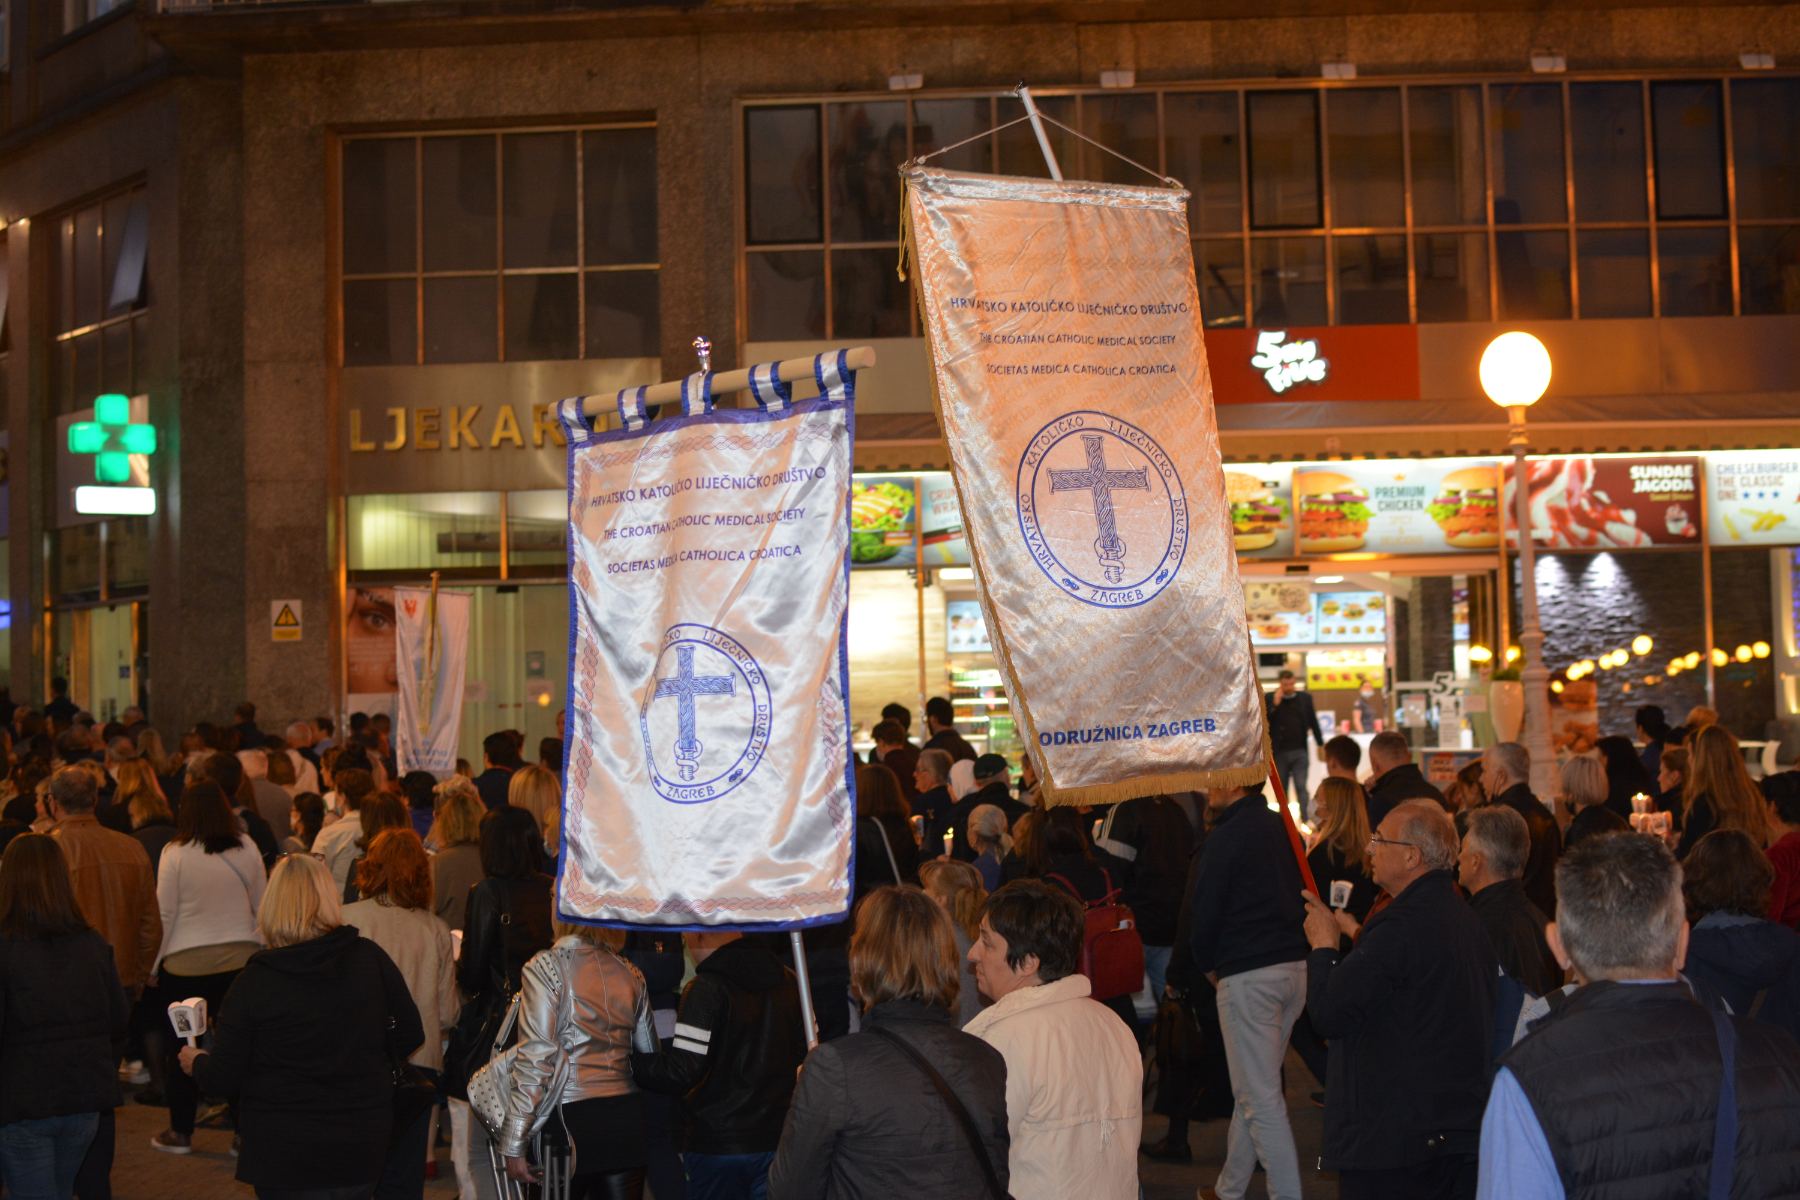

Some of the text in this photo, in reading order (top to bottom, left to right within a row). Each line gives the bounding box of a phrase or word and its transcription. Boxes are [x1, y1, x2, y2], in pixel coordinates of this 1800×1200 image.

[950, 297, 1188, 316] HRVATSKO KATOLIČKO LIJEČNIČKO DRUŠTVO
[993, 334, 1045, 345] CROATIAN
[1047, 333, 1095, 345] CATHOLIC
[1096, 336, 1138, 346] MEDICAL
[1139, 335, 1176, 345] SOCIETY
[986, 363, 1177, 376] SOCIETAS MEDICA CATHOLICA CROATICA
[1025, 416, 1084, 469] KATOLIČKO
[1629, 464, 1694, 479] SUNDAE
[591, 489, 636, 507] HRVATSKO
[695, 475, 771, 490] LIJEČNIČKO
[772, 466, 826, 485] DRUŠTVO
[1632, 479, 1695, 493] JAGODA
[1740, 475, 1784, 487] CLASSIC
[1374, 486, 1425, 499] PREMIUM
[1377, 499, 1424, 512] CHICKEN
[604, 528, 618, 540] THE
[620, 521, 671, 538] CROATIAN
[714, 514, 765, 526] MEDICAL
[766, 508, 806, 524] SOCIETY
[1021, 494, 1055, 571] HRVATSKO
[607, 559, 655, 574] SOCIETAS
[679, 550, 746, 561] CATHOLICA
[1090, 589, 1144, 603] ZAGREB
[1039, 718, 1217, 747] ODRUŽNICA ZAGREB
[666, 785, 715, 800] ZAGREB
